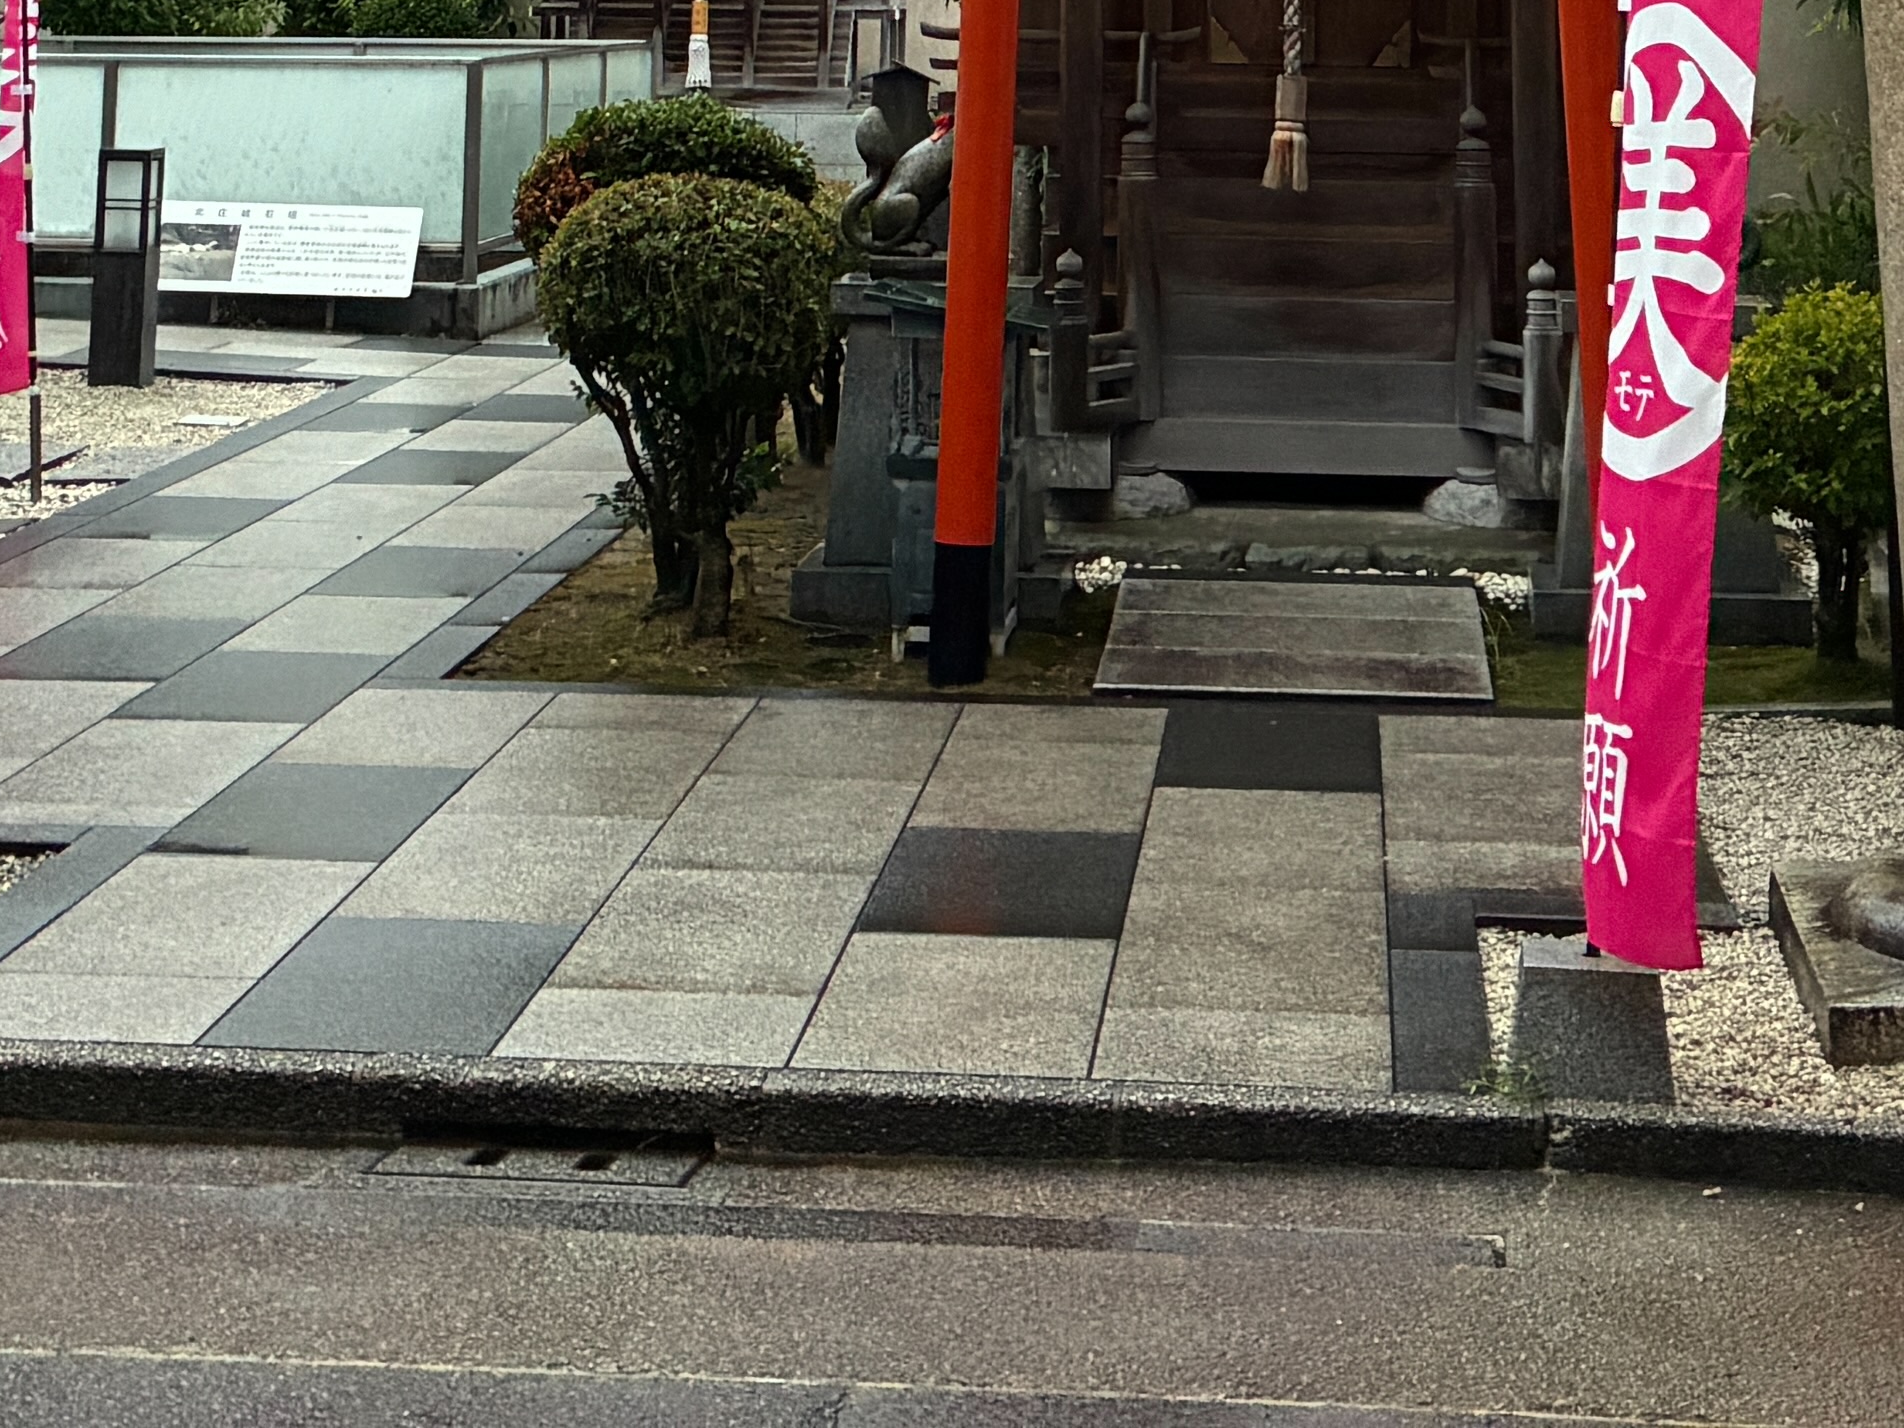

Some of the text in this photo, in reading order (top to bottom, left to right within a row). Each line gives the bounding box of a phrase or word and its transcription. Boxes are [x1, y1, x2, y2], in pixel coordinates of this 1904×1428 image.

[1608, 60, 1726, 408] 美
[1614, 370, 1654, 421] モテ
[1581, 519, 1648, 887] 祈願
